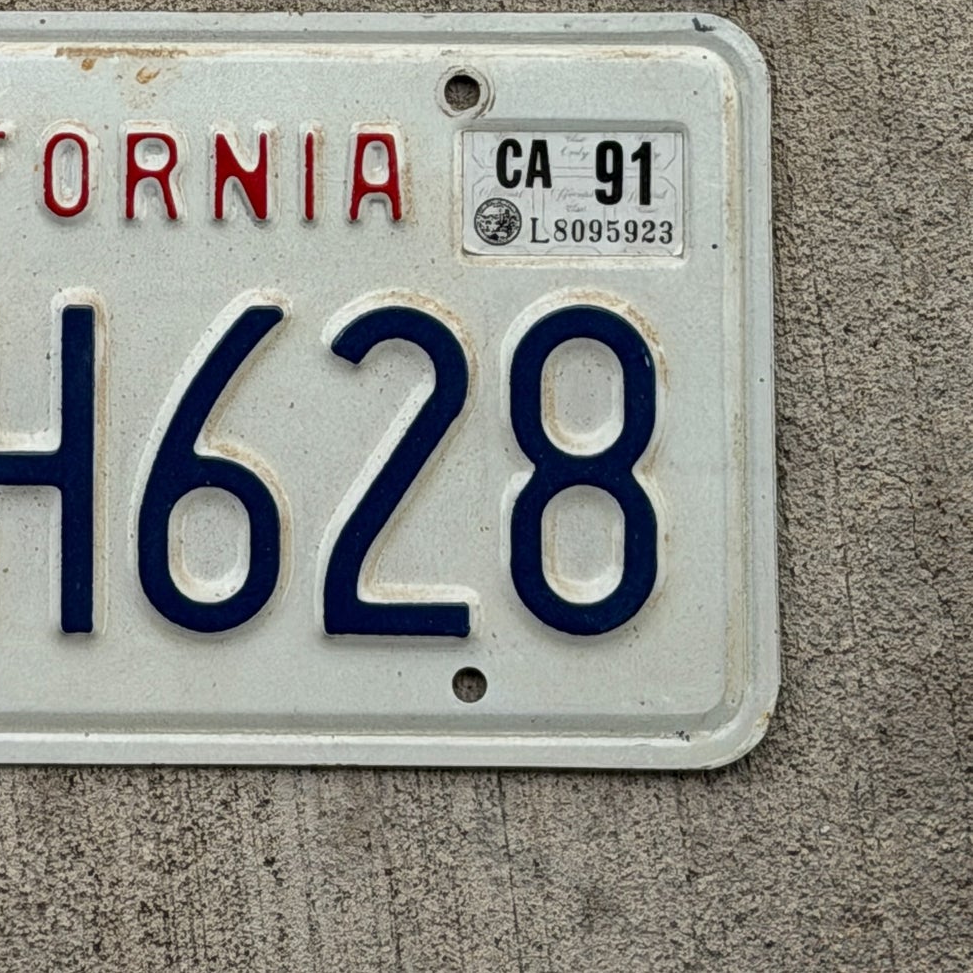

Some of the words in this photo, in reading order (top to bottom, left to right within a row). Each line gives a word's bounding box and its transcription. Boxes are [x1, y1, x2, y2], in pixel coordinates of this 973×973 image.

[496, 138, 552, 189] CA
[595, 140, 652, 206] 91
[530, 217, 674, 245] L8095923
